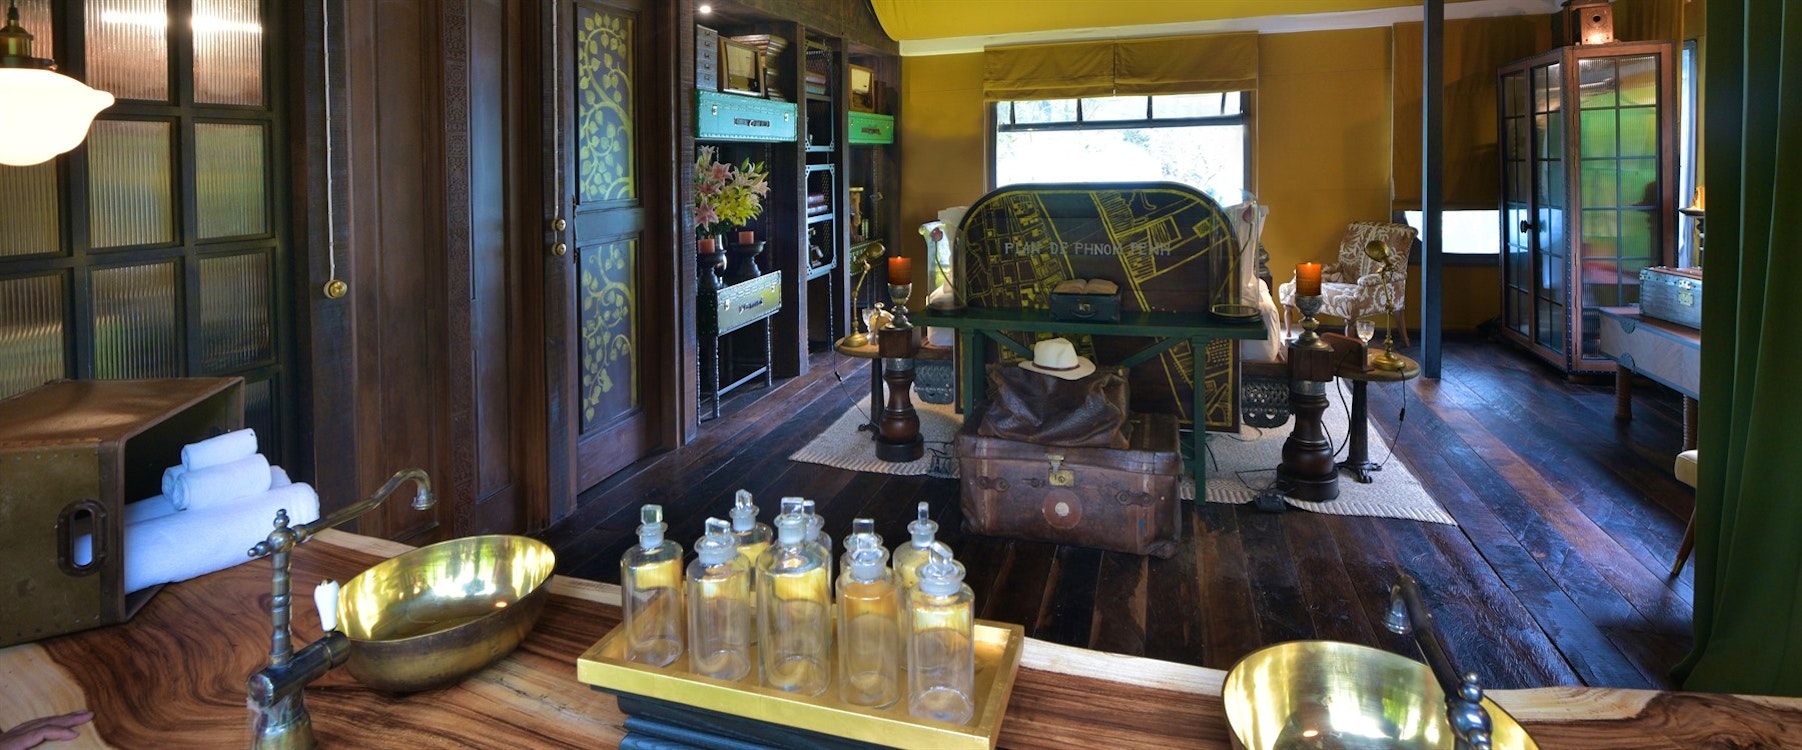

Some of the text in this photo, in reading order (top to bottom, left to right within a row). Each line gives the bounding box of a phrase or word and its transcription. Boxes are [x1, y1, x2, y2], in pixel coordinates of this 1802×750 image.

[1004, 242, 1040, 255] PLAN
[1075, 242, 1122, 256] PHNOM
[1131, 242, 1171, 256] PENH
